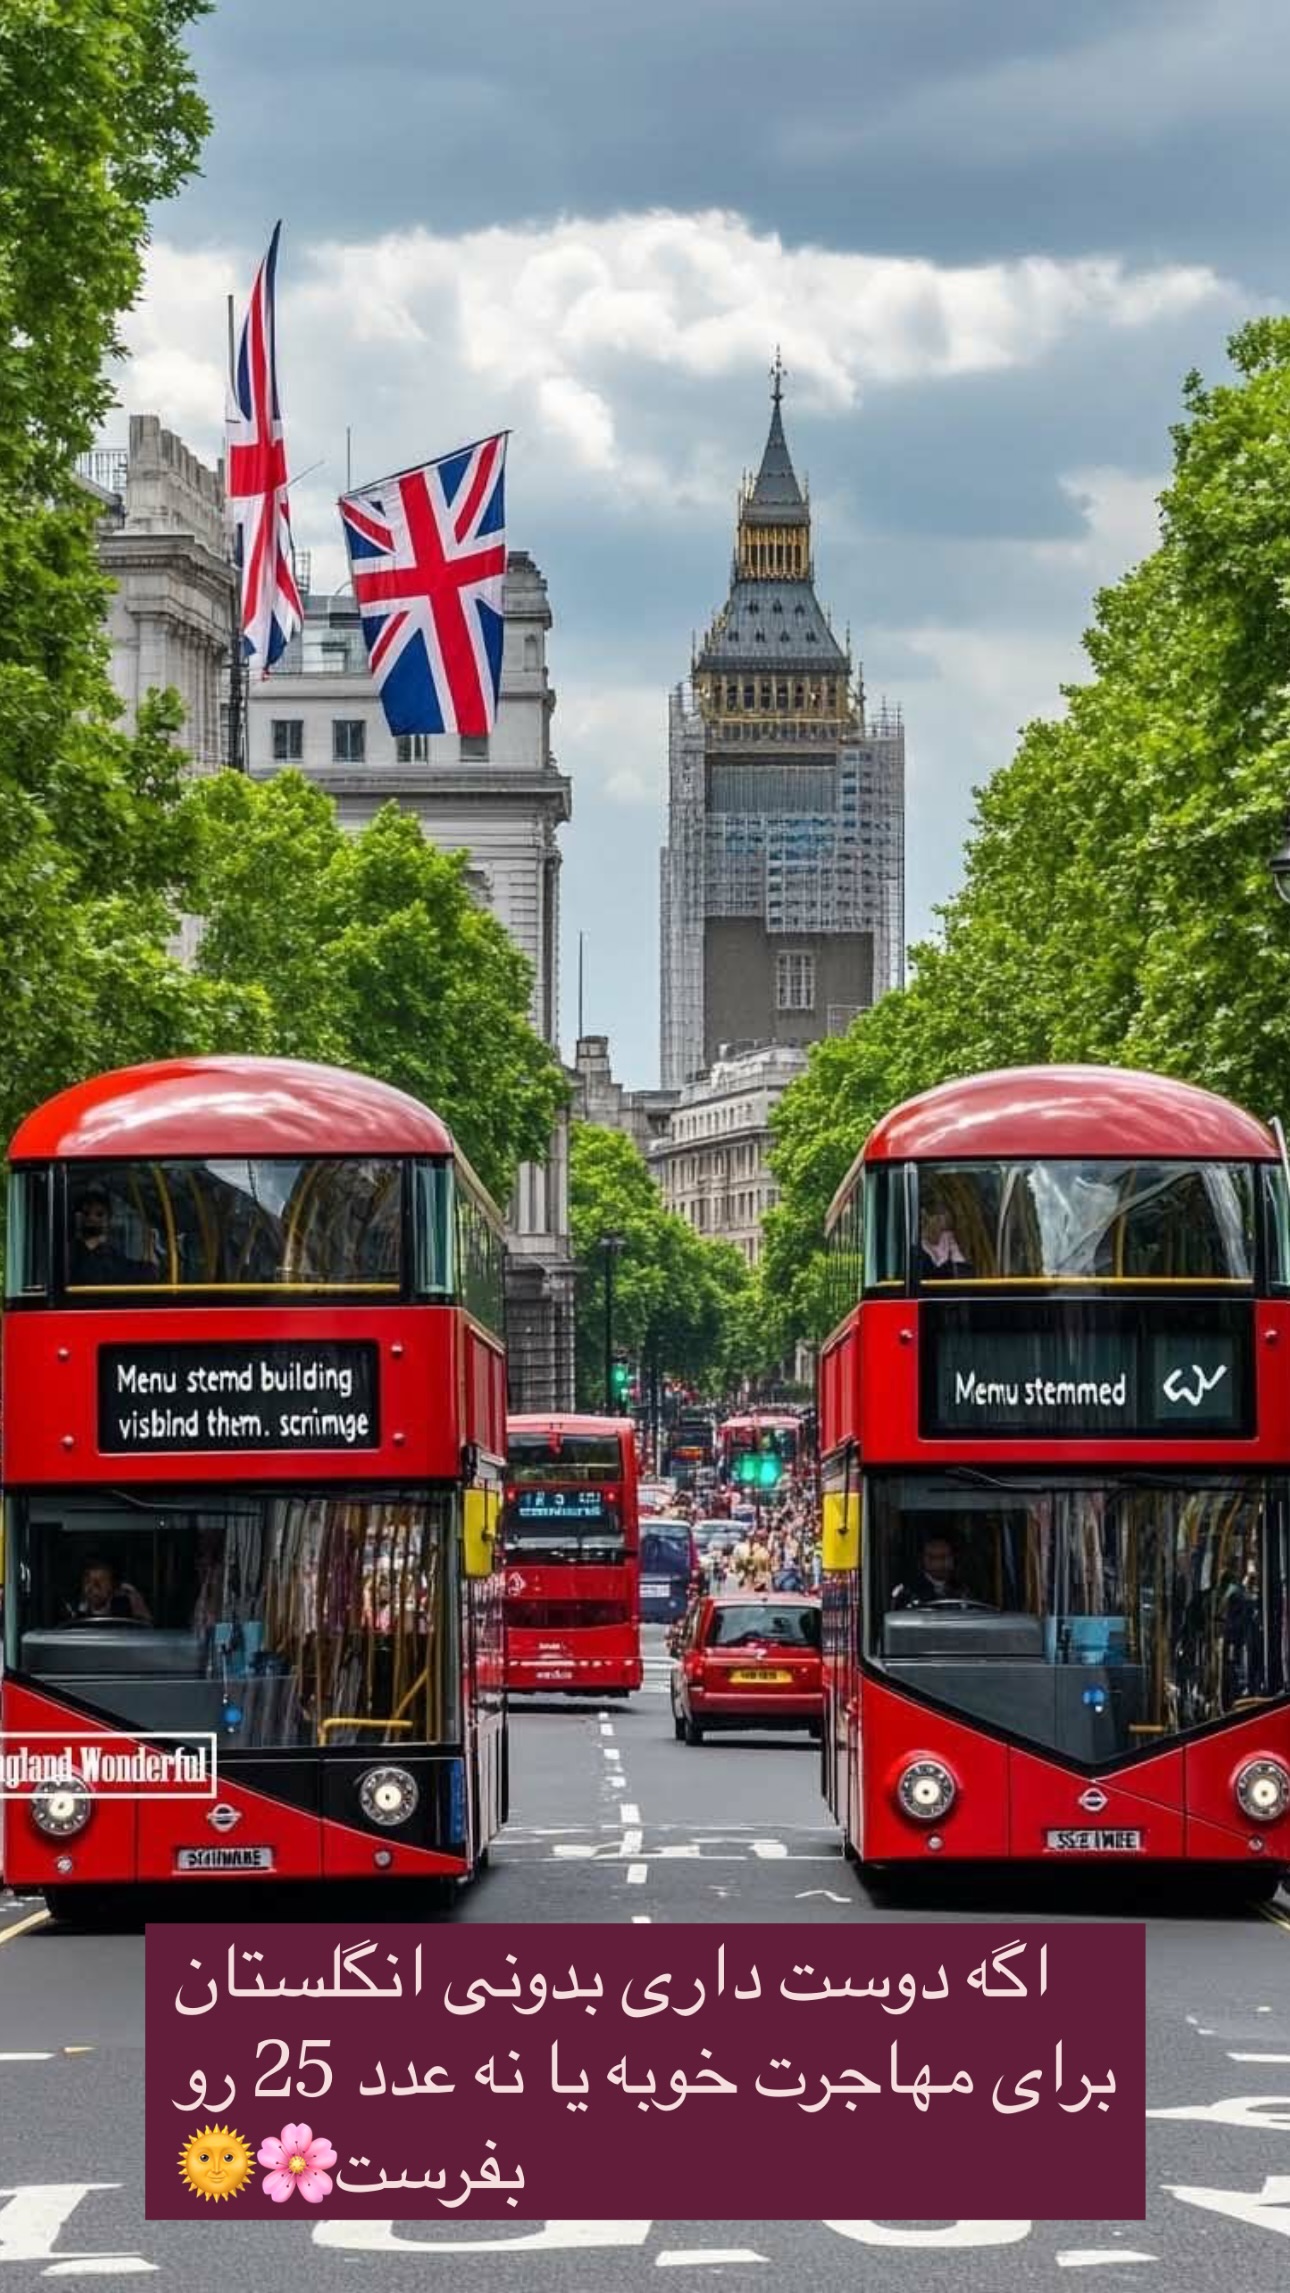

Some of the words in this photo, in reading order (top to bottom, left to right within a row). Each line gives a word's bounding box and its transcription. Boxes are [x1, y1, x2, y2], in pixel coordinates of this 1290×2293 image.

[117, 1364, 177, 1394] Menu
[260, 1361, 353, 1398] building
[1024, 1373, 1127, 1406] stemmed
